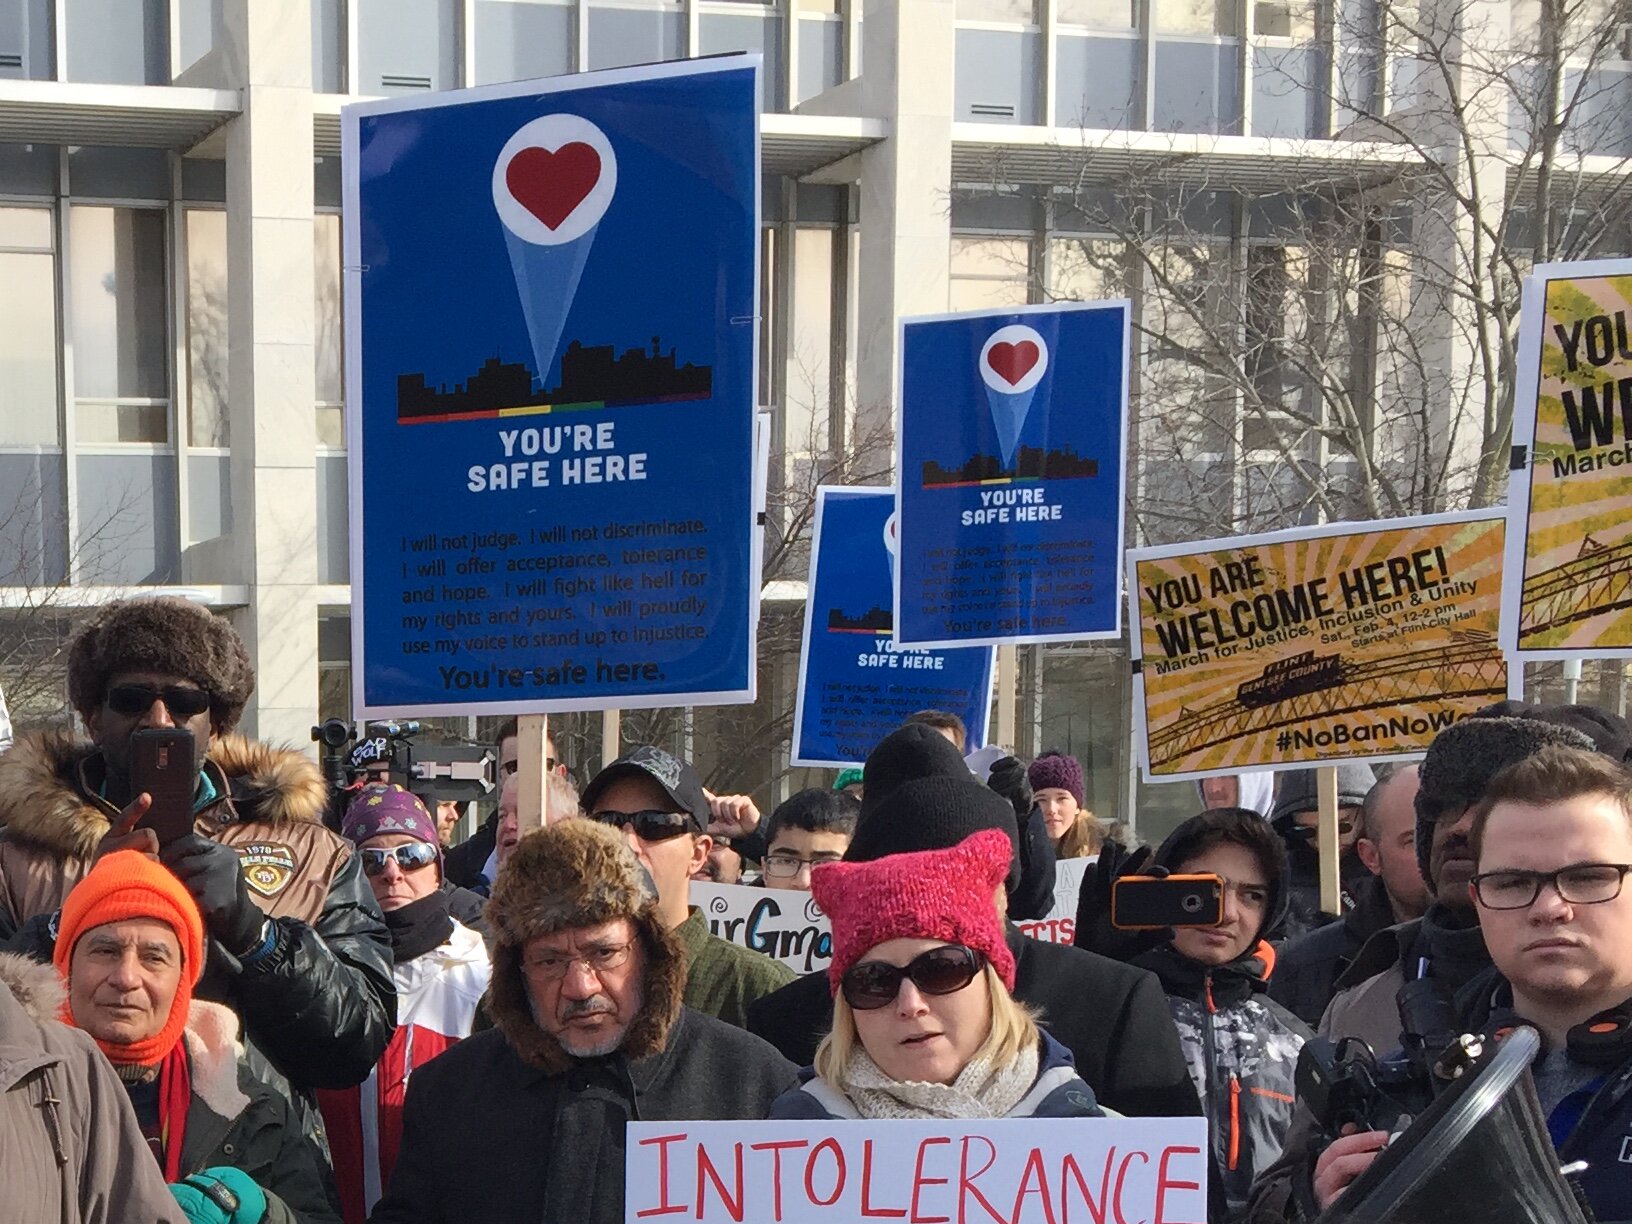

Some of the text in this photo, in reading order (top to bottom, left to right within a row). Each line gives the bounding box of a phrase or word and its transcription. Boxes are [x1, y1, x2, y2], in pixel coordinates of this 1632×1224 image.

[499, 422, 614, 456] YOU'RE
[468, 453, 648, 493] SAFE HERE
[980, 488, 1044, 506] YOU'RE
[962, 504, 1062, 526] SAFE HERE
[1145, 556, 1264, 613] YOU ARE
[1155, 577, 1335, 658] WELCOME
[1339, 546, 1450, 609] HERE!
[1403, 608, 1430, 623] 12-2
[1434, 602, 1456, 618] pm
[1454, 609, 1477, 622] Hall
[1156, 579, 1477, 675] March for Justice, Inclusion & Unity
[440, 658, 665, 690] You're safe here.
[858, 654, 944, 670] SAFE HERE
[1288, 658, 1334, 680] COUNTY
